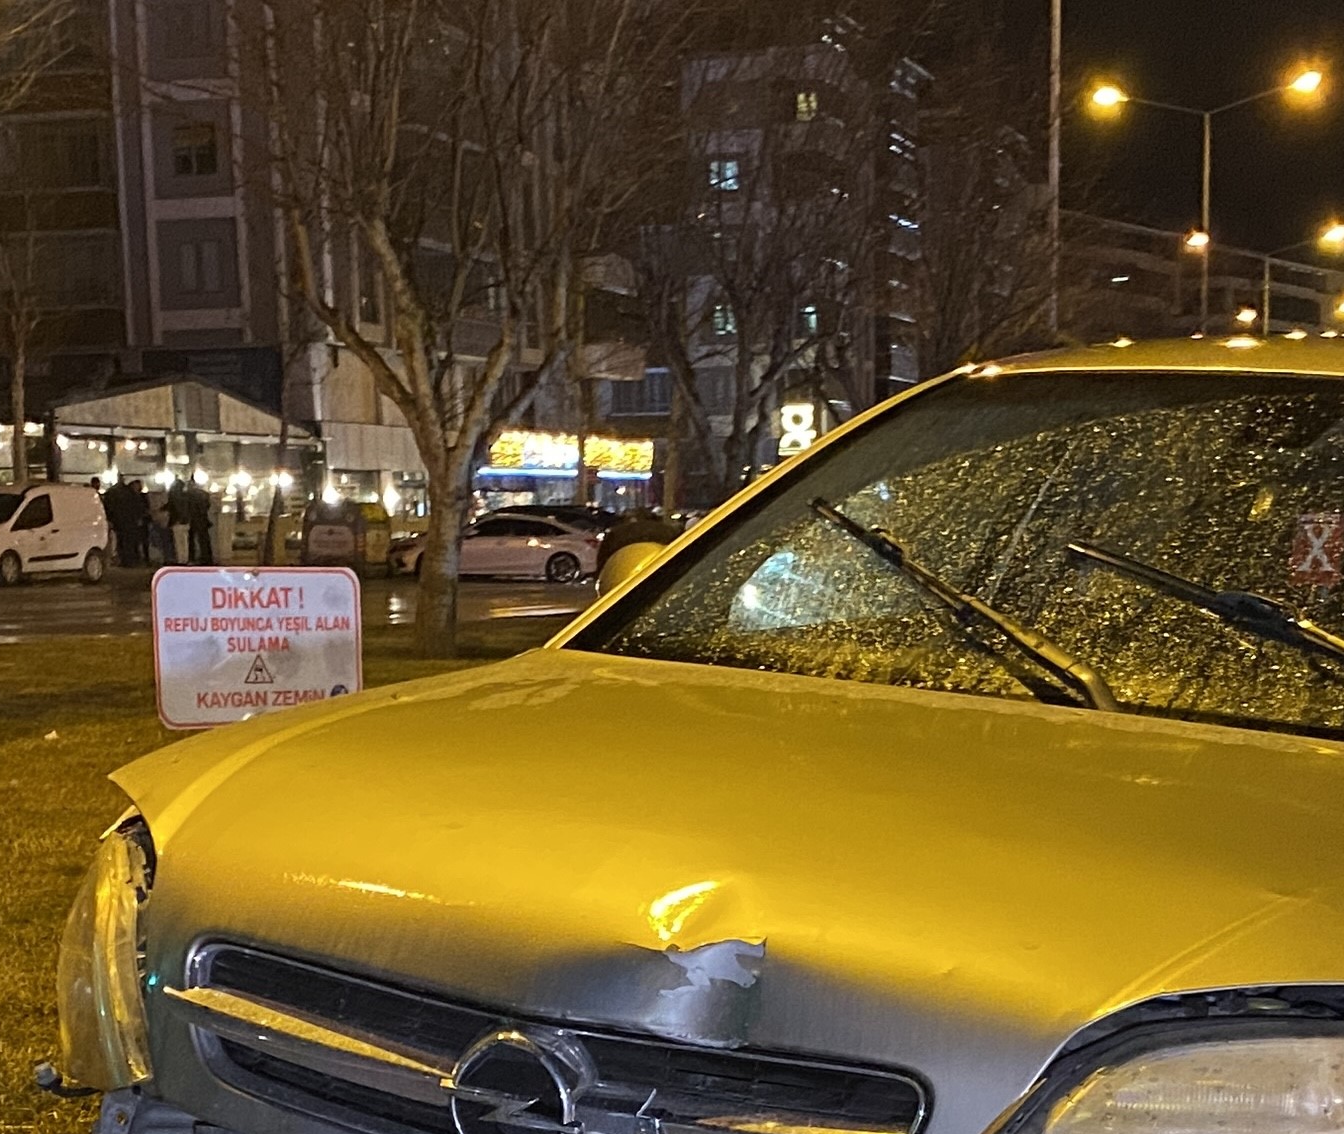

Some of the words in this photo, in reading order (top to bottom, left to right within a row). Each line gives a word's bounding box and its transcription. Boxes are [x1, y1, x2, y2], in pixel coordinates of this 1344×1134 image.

[211, 616, 273, 632] BOYUNCA
[315, 615, 350, 632] ALAN
[226, 636, 290, 653] SULAMA
[197, 690, 268, 709] KAYGAN
